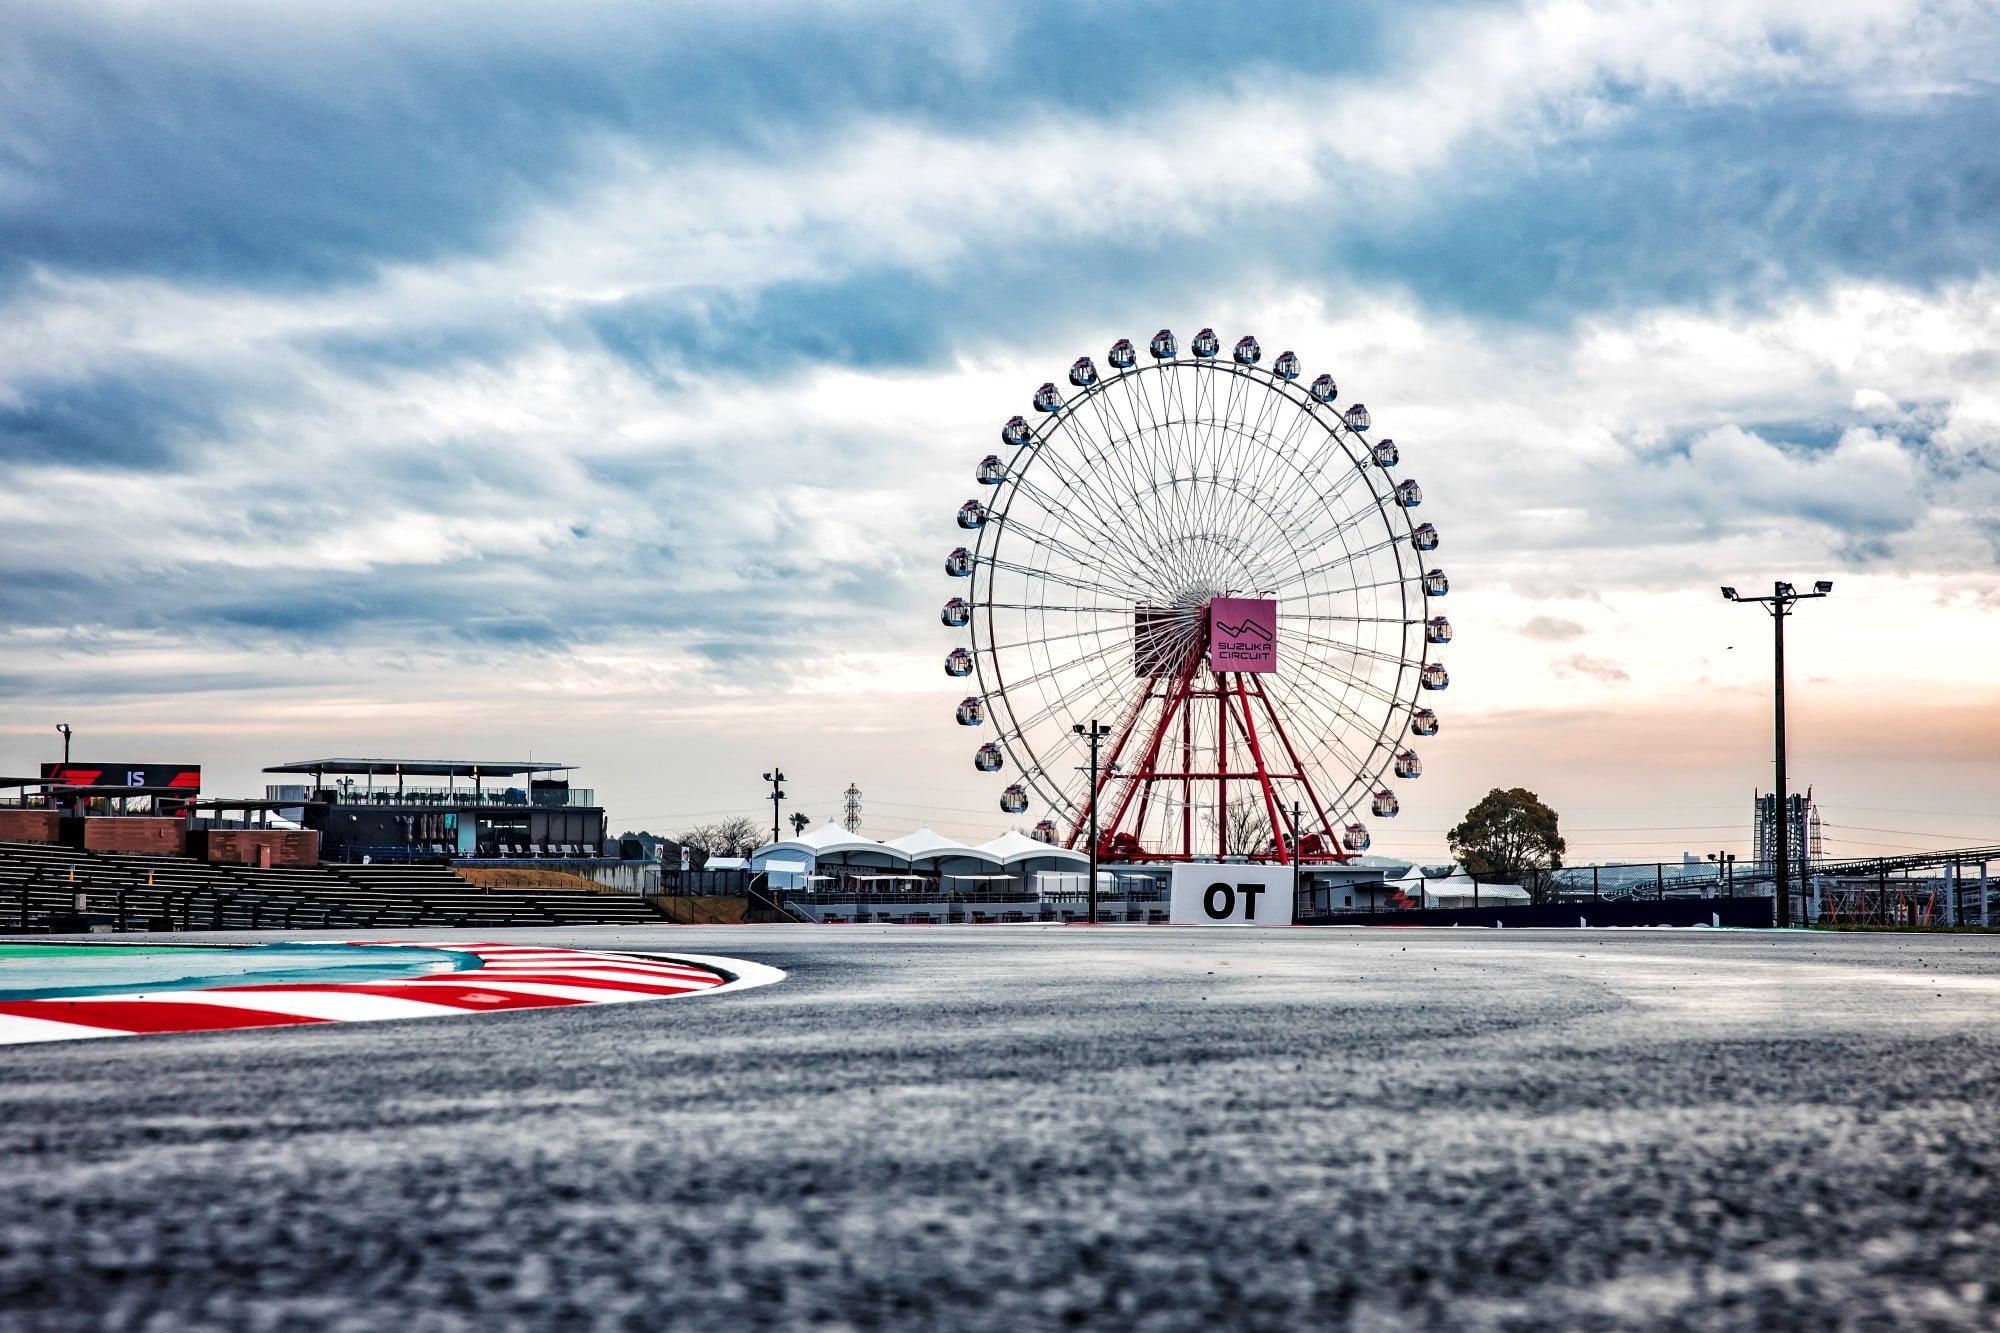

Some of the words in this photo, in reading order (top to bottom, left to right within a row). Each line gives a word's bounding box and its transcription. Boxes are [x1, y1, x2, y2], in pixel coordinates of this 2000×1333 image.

[1218, 642, 1272, 651] SUZUKA
[1219, 652, 1270, 660] CIRCUIT
[127, 771, 145, 787] IS
[1203, 882, 1266, 920] OT
